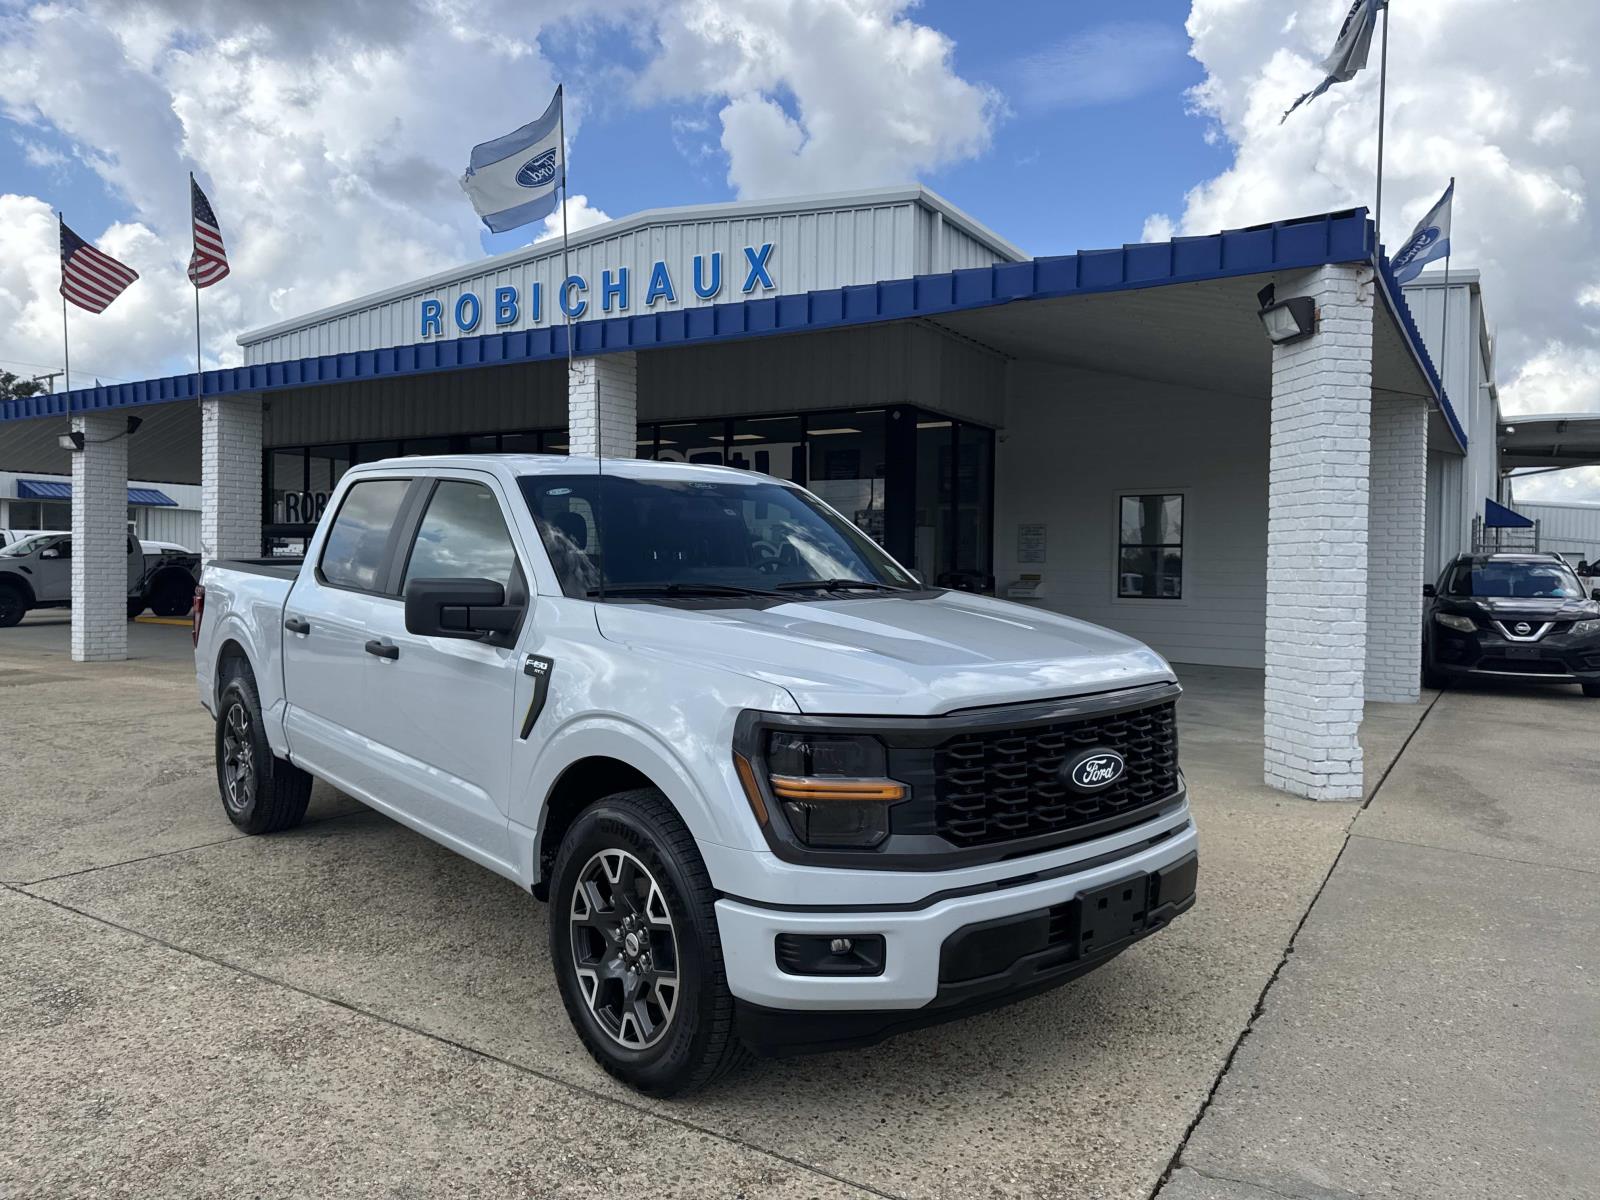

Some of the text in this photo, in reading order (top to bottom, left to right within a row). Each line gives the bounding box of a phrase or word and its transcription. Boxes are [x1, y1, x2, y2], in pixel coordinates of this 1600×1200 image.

[420, 242, 775, 338] ROBICHAUX
[285, 491, 333, 523] ROB
[1083, 759, 1115, 783] Ford
